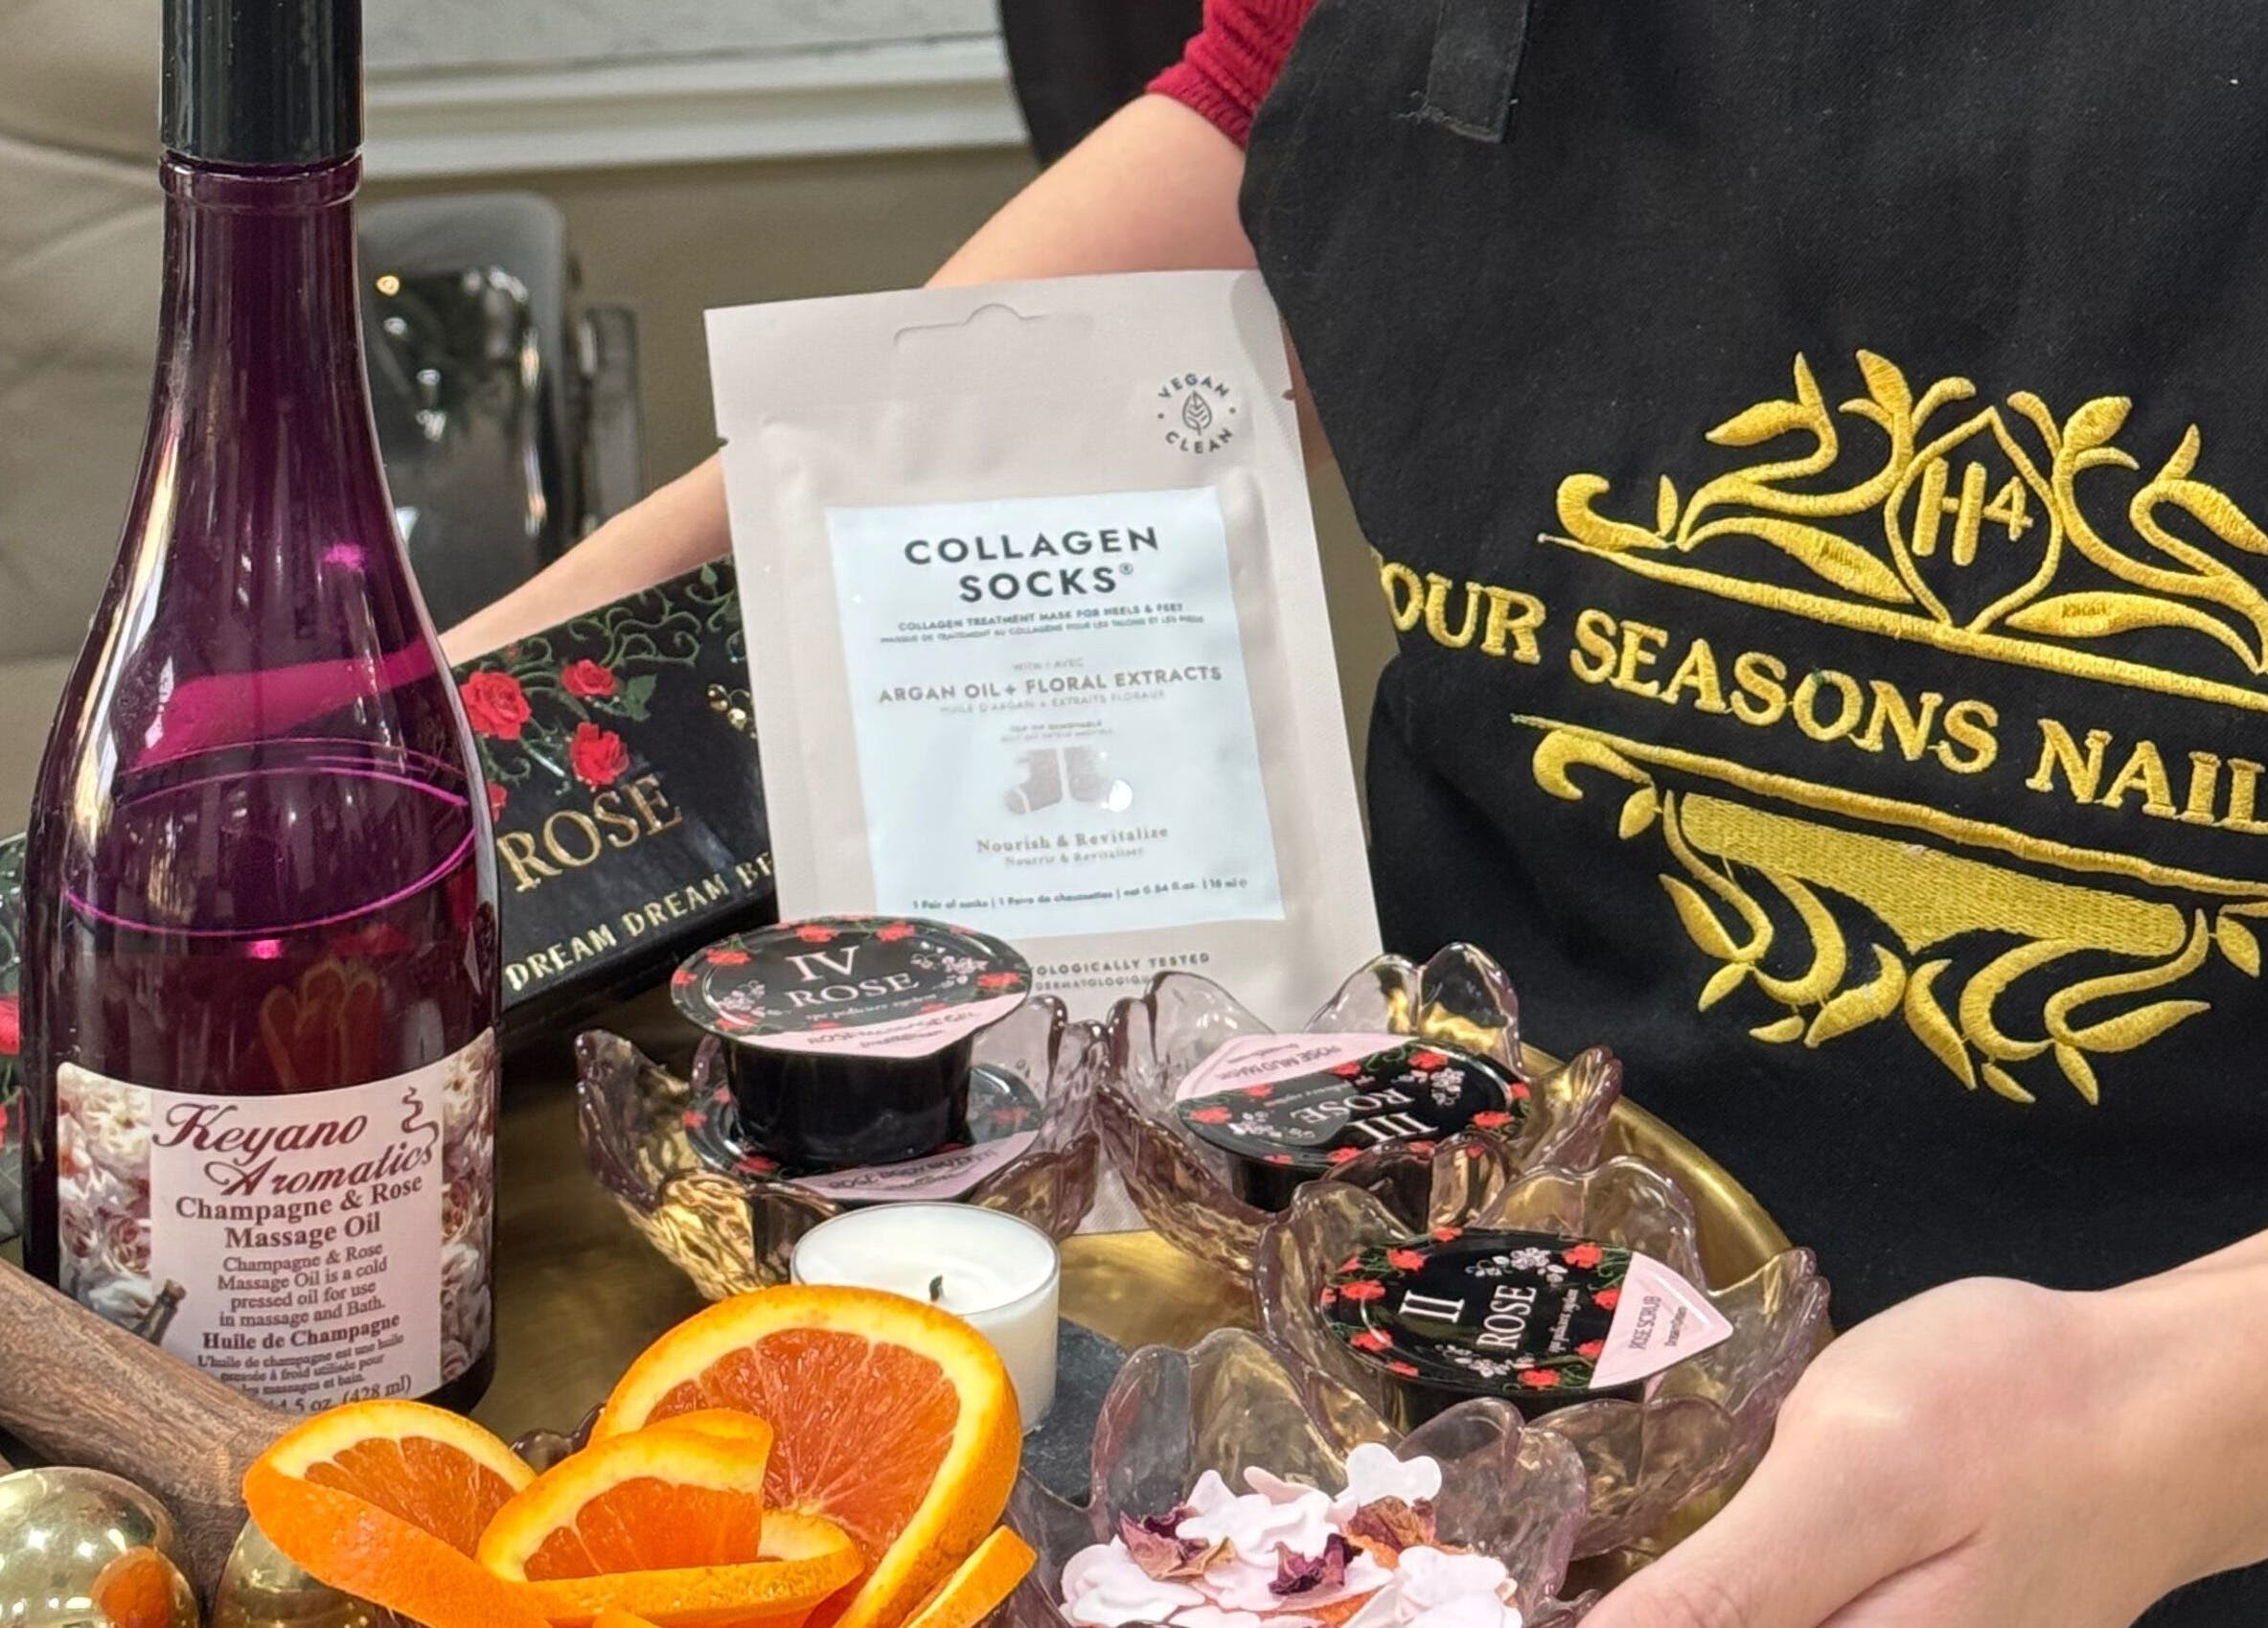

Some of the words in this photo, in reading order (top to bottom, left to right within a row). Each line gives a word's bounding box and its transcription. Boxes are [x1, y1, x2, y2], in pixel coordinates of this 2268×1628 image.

[1157, 373, 1229, 398] VEGAN
[1165, 427, 1233, 454] CLEAN
[905, 526, 1158, 564] COLLAGEN
[898, 619, 963, 631] COLLAGEN
[966, 612, 1035, 626] TREATMENT
[1076, 608, 1100, 619] FOR
[1104, 605, 1140, 616] HEELS
[1157, 602, 1183, 613] FEET
[880, 684, 956, 704] ARGAN
[964, 681, 1000, 699] OIL
[1025, 674, 1107, 695] FLORAL
[1114, 665, 1223, 687] EXTRACTS
[1380, 562, 1546, 664] OUR
[1569, 608, 1999, 774] SEASONS
[496, 773, 683, 893] ROSE
[976, 836, 1051, 853] Nourish
[1057, 835, 1068, 848] &
[1075, 827, 1169, 846] Revitalize
[504, 924, 618, 992] DREAM
[622, 873, 730, 937] DREAM
[786, 945, 860, 981] IV
[1031, 959, 1140, 976] OLOGICALLY
[1149, 952, 1210, 968] TESTED
[785, 973, 920, 1008] ROSE
[1035, 975, 1154, 992] DERMATOLOGIQU
[1291, 1088, 1415, 1124] ROSE
[152, 1102, 368, 1166] Keyano
[1346, 1112, 1439, 1142] III
[204, 1140, 433, 1198] Aromatics
[175, 1196, 332, 1226] Champagne
[340, 1189, 364, 1209] &
[370, 1175, 423, 1206] Rose
[224, 1226, 336, 1249] Massage
[344, 1210, 381, 1237] Oil
[218, 1275, 289, 1293] Massage
[294, 1271, 320, 1288] Oil
[325, 1269, 338, 1283] is
[343, 1268, 352, 1280] a
[355, 1256, 388, 1277] cold
[222, 1255, 321, 1274] Champagne
[325, 1250, 341, 1264] &
[345, 1243, 383, 1262] Rose
[231, 1292, 292, 1312] pressed
[297, 1290, 318, 1305] oil
[324, 1286, 346, 1302] for
[351, 1280, 377, 1296] use
[1399, 1289, 1465, 1324] II
[1637, 1296, 1662, 1330] SCRUB
[202, 1331, 257, 1350] Huile
[262, 1332, 286, 1348] de
[290, 1314, 401, 1347] Champagne
[219, 1312, 236, 1327] in
[241, 1309, 309, 1328] massage
[313, 1304, 342, 1322] and
[1477, 1285, 1538, 1352] ROSE
[1629, 1326, 1653, 1350] ROSE
[244, 1355, 260, 1368] de
[263, 1349, 332, 1369] champagne
[281, 1366, 310, 1381] froid
[384, 1373, 412, 1398] ml)
